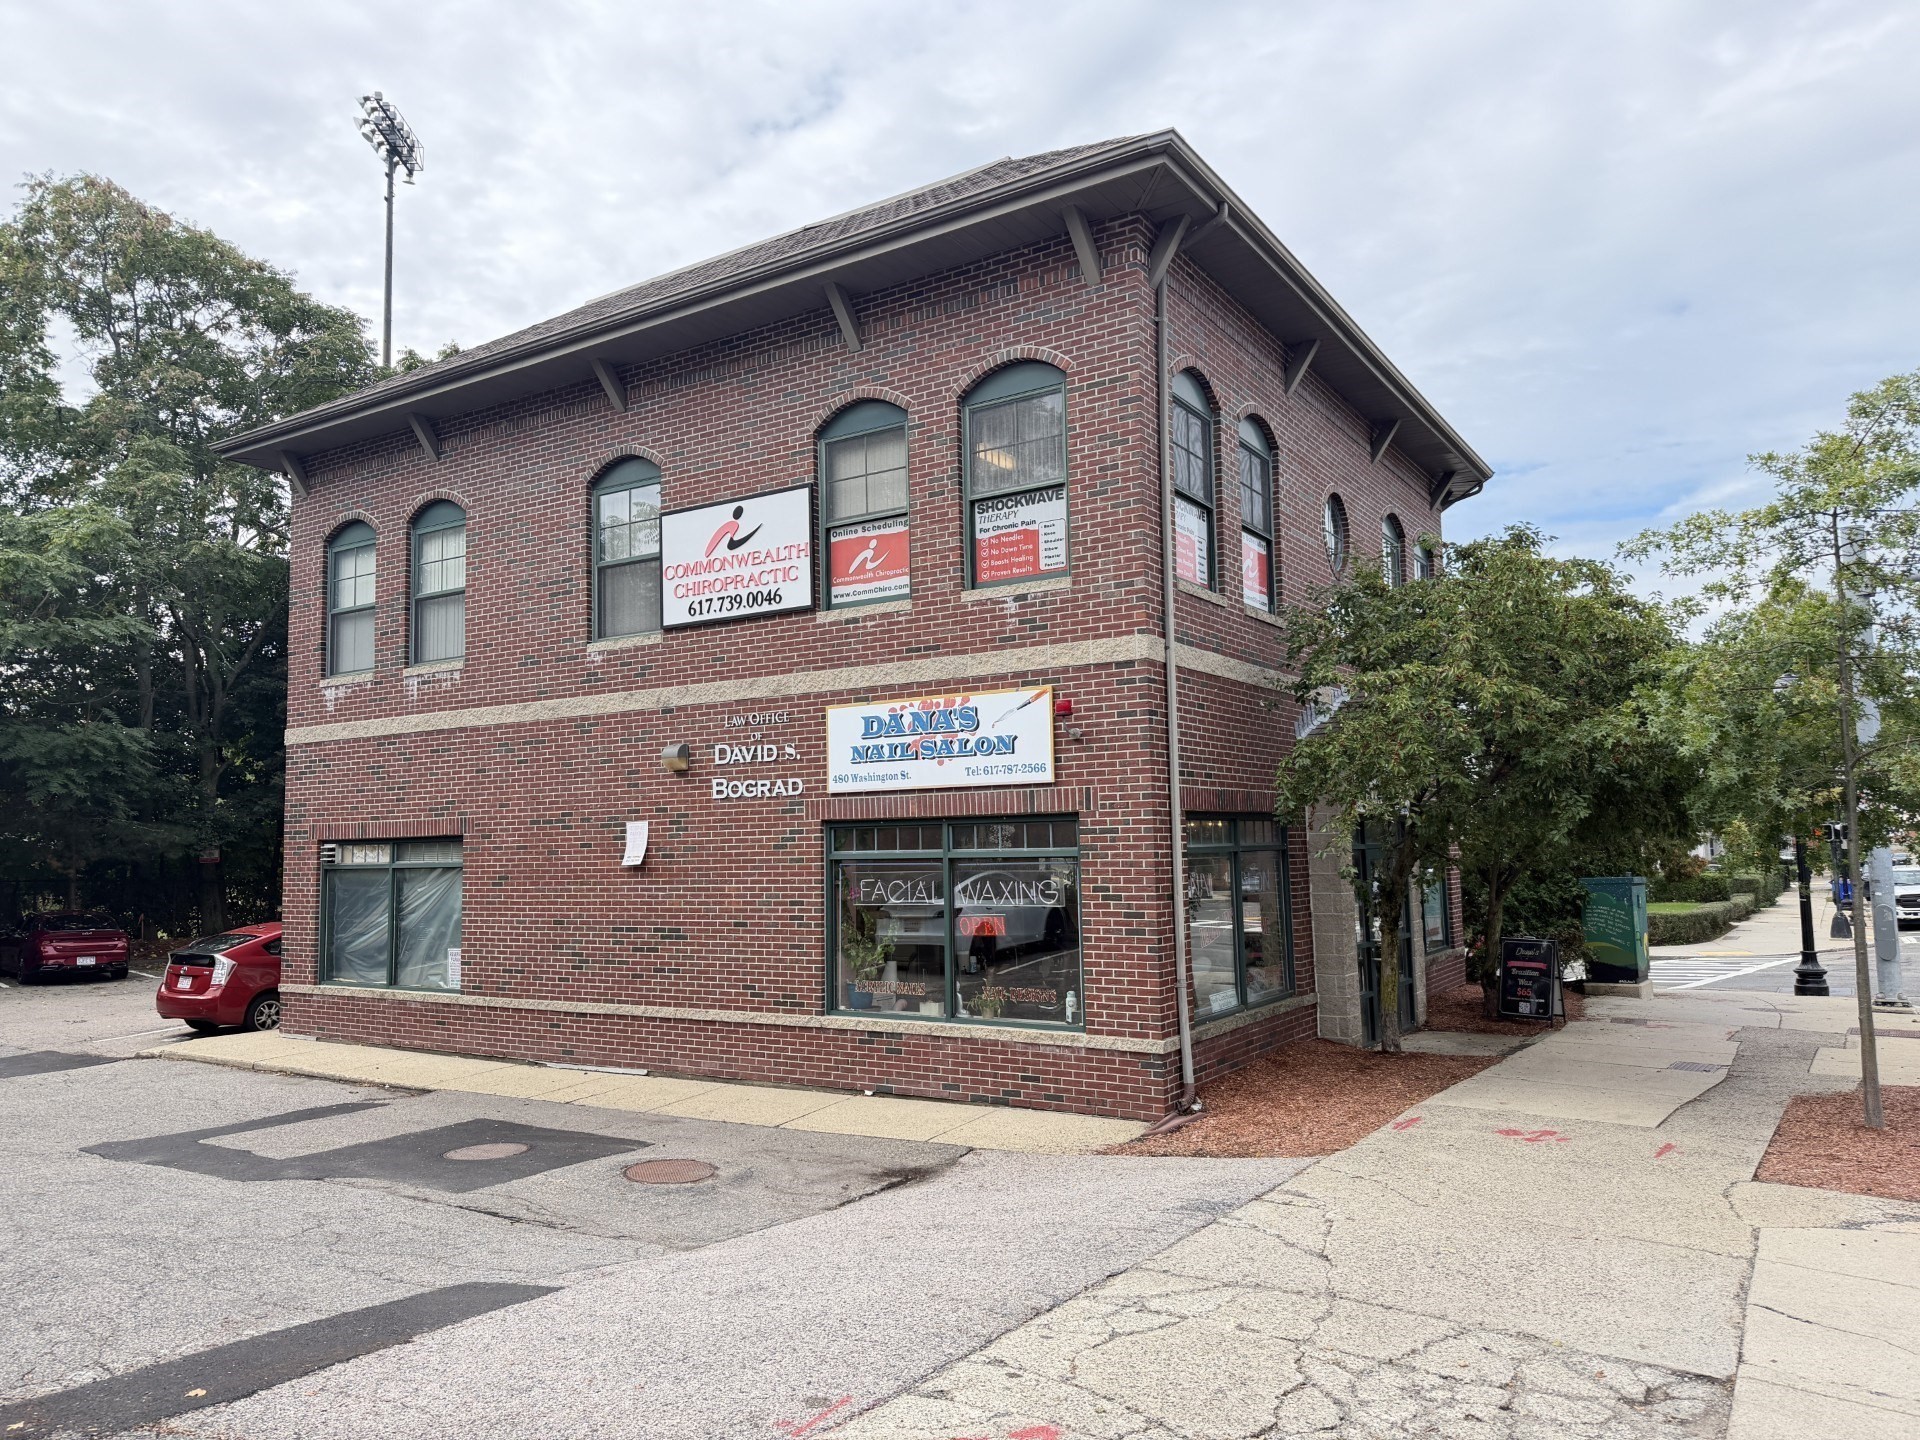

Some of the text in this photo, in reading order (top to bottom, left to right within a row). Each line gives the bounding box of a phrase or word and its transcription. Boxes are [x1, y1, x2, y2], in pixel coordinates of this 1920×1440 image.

[976, 488, 1065, 514] SHOCKWAVE
[978, 510, 1019, 524] THERAPY
[992, 522, 1018, 531] Chronic
[1020, 519, 1036, 527] Pain
[832, 519, 909, 538] Online Scheduling
[1000, 533, 1024, 543] Needles
[1000, 546, 1017, 554] Down
[664, 542, 809, 580] COMMONWEALTH
[990, 555, 1034, 566] Boosts Healing
[832, 567, 909, 583] Commonwealth Chiropractic
[991, 564, 1033, 577] Proven Results
[673, 565, 799, 598] CHIROPRACTIC
[833, 583, 909, 599] www.CommChiro.com
[688, 588, 782, 616] 617.739.0046
[861, 705, 980, 740] DANA'S
[784, 742, 801, 760] S.
[850, 734, 1018, 764] NAIL SALON
[832, 770, 912, 785] 480 Washington St.
[983, 763, 1047, 776] 617-787-2566
[859, 879, 1059, 905] FACIAL WAXING
[959, 916, 1006, 936] OPEN
